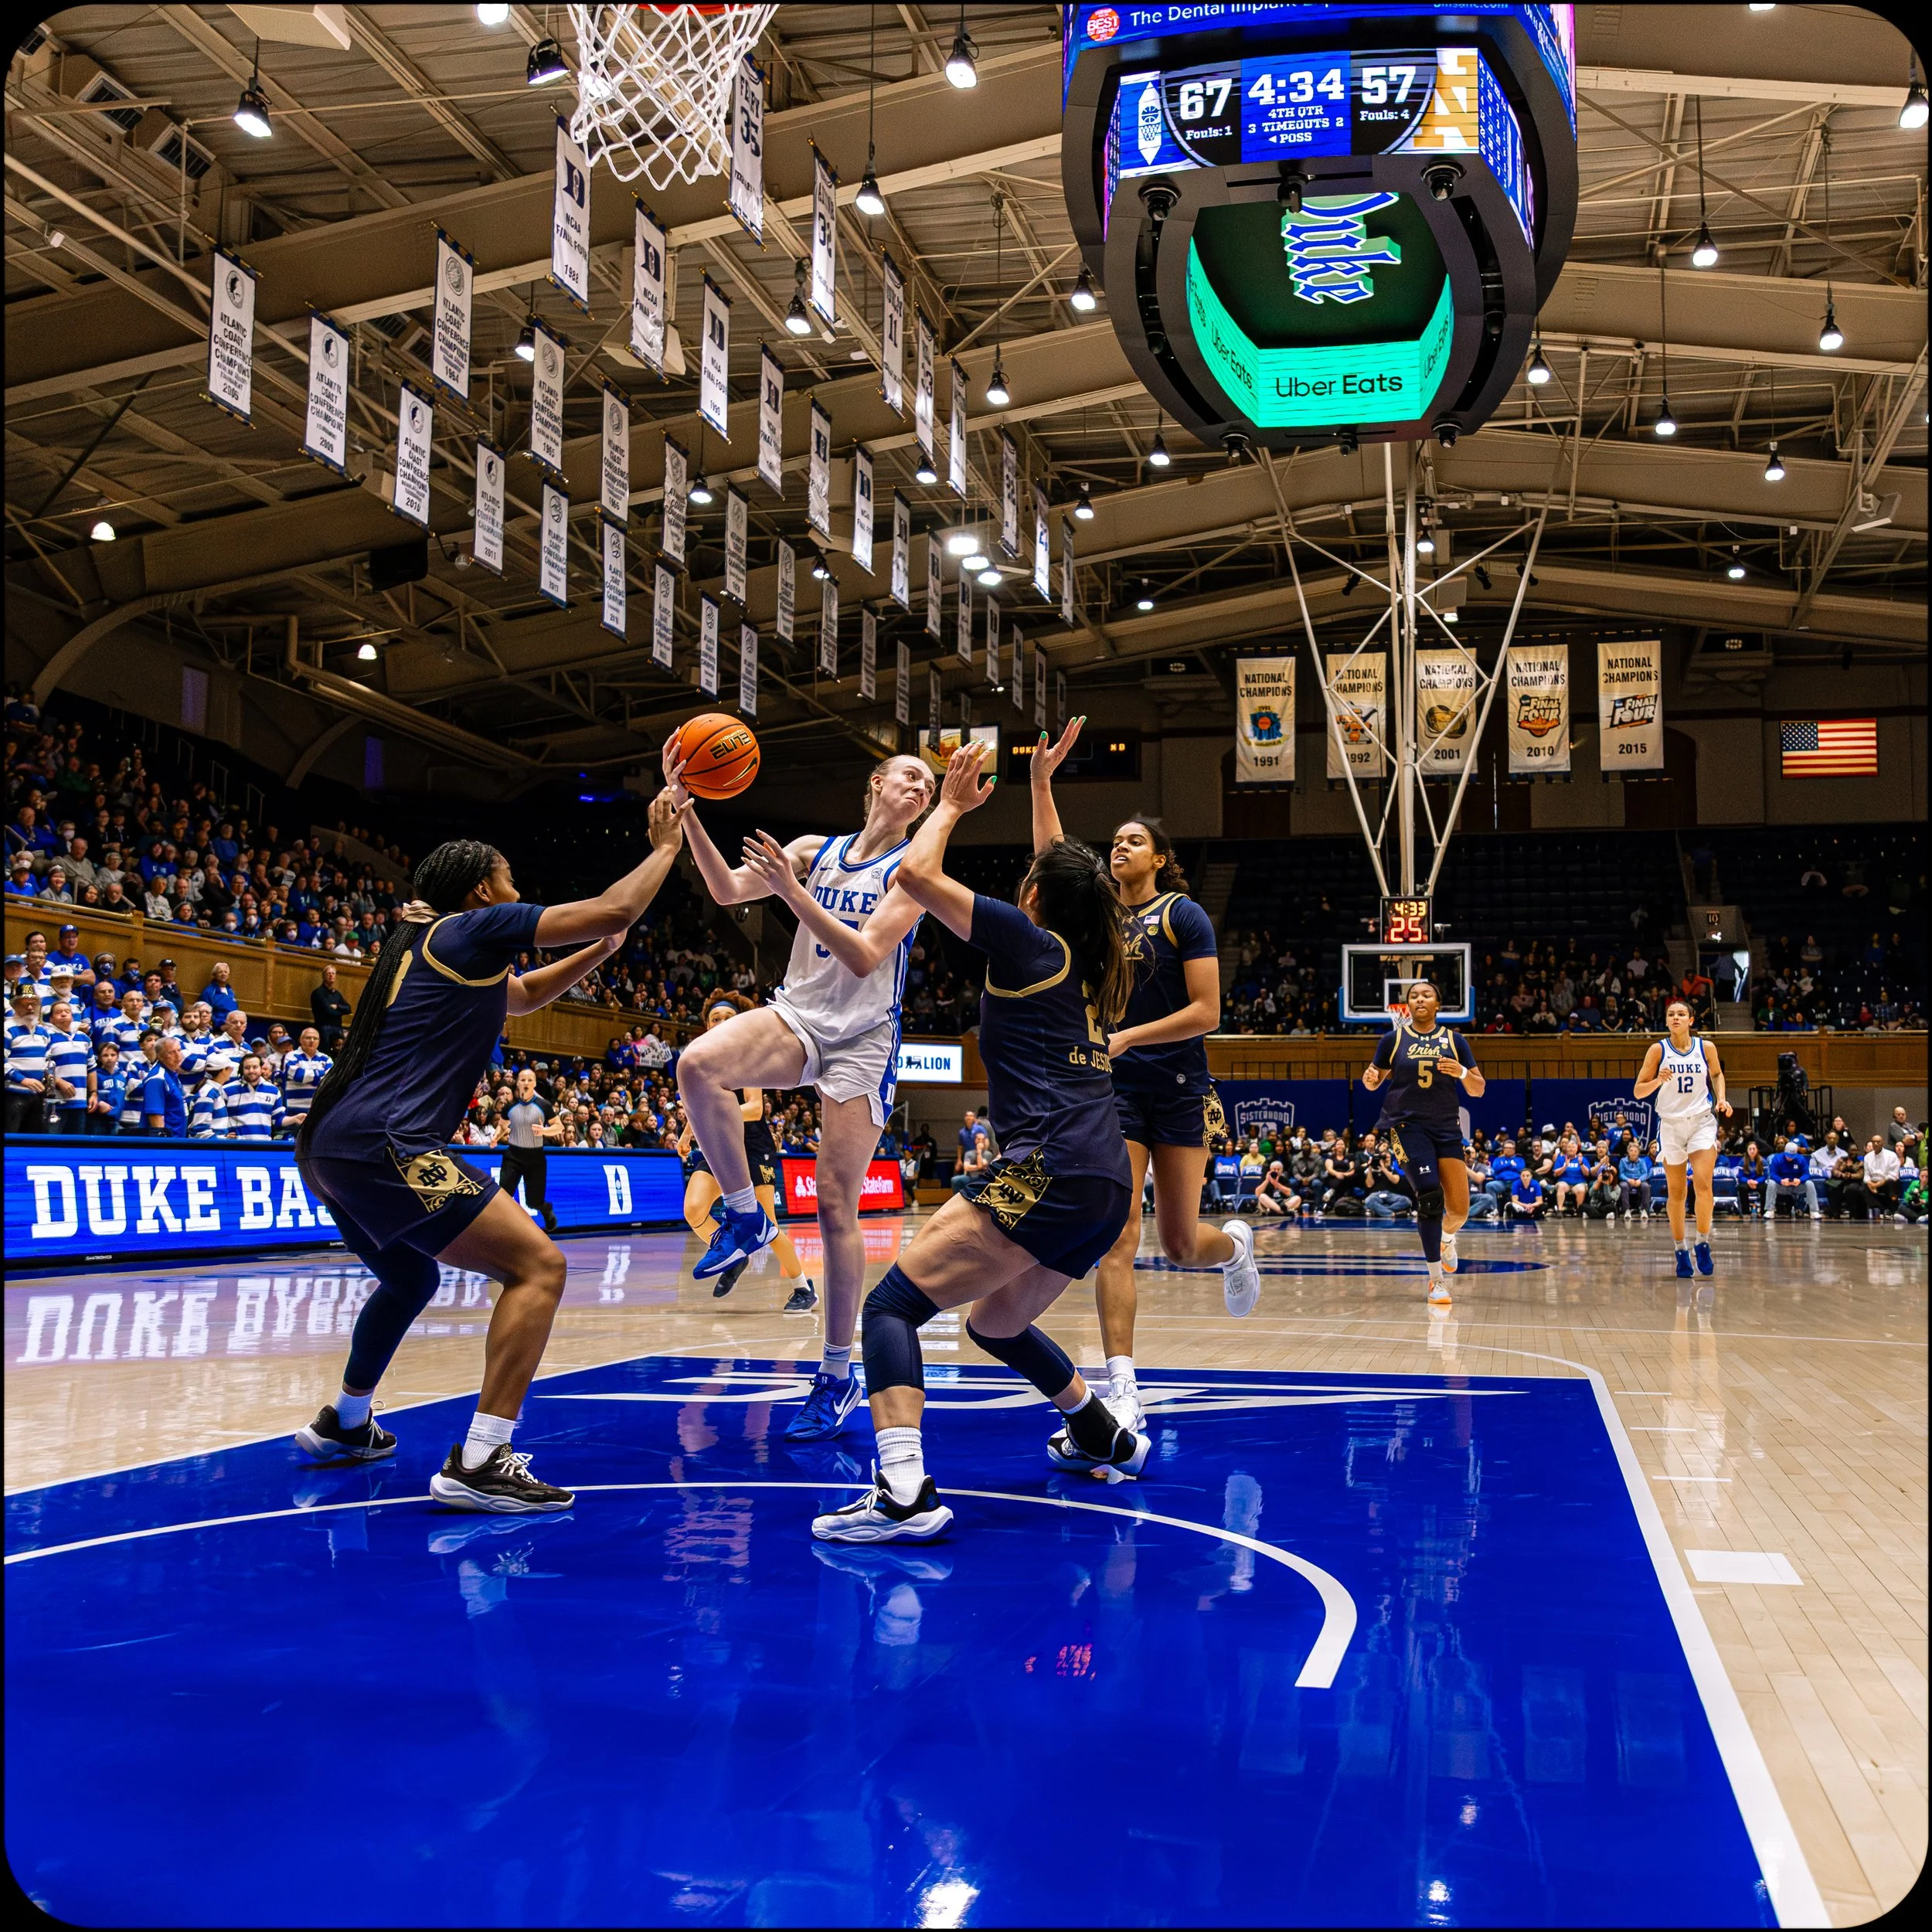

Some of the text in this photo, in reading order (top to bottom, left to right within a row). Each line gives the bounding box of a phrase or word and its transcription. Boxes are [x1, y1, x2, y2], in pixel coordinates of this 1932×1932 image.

[1130, 4, 1225, 26] The Dental
[1087, 17, 1118, 32] BEST
[1248, 70, 1345, 105] 4:34
[1362, 66, 1416, 104] 57
[1179, 78, 1232, 120] 67
[1268, 106, 1324, 118] 4TH QTR
[1359, 109, 1410, 121] Fouls: 4
[740, 106, 760, 158] 35
[1185, 126, 1232, 141] Fouls: 1
[1248, 117, 1344, 134] 3 TIMEOUTS 2
[1280, 132, 1312, 144] POSS
[566, 213, 581, 235] NCAA
[556, 224, 587, 261] FINAL FOUR
[643, 287, 658, 307] NCAA
[220, 312, 247, 338] ATLANTIC
[889, 313, 897, 348] 11
[224, 328, 243, 348] COAST
[213, 334, 252, 366] CONFERENCE
[215, 349, 250, 378] CHAMPIONS
[316, 372, 342, 394] ATLANTIC
[704, 366, 715, 386] FINAL
[1276, 372, 1403, 397] Uber Eats
[321, 386, 338, 403] COAST
[310, 393, 345, 422] CONFERENCE
[311, 406, 343, 433] CHAMPIONS
[404, 437, 426, 458] ATLANTIC
[409, 451, 422, 466] COAST
[398, 457, 429, 482] CONFERENCE
[400, 468, 427, 493] CHAMPIONS
[406, 497, 420, 512] 2010
[1425, 665, 1468, 676] NATIONAL
[1515, 660, 1560, 673] NATIONAL
[1607, 657, 1652, 669] NATIONAL
[1245, 672, 1287, 684] NATIONAL
[1420, 677, 1473, 689] CHAMPIONS
[1512, 674, 1565, 687] CHAMPIONS
[1602, 670, 1658, 683] CHAMPIONS
[1240, 685, 1292, 698] CHAMPIONS
[1333, 681, 1383, 694] HAMPIONS
[1530, 696, 1559, 709] FINAL
[1625, 696, 1656, 709] FINAL
[1519, 705, 1561, 723] FOUR
[1614, 706, 1656, 726] FOUR
[709, 732, 752, 760] ELITE
[1012, 745, 1038, 755] DUKE
[1434, 749, 1460, 760] 2001
[1526, 746, 1554, 757] 2010
[1618, 743, 1647, 754] 2015
[1253, 756, 1279, 767] 1991
[815, 886, 878, 915] DUKE
[1395, 901, 1427, 917] 4:33
[1390, 917, 1422, 942] 25
[1069, 1046, 1087, 1065] de
[1407, 1043, 1442, 1059] Irish
[924, 1057, 951, 1070] LION
[1669, 1063, 1701, 1073] DUKE
[1417, 1060, 1433, 1088] 5
[1677, 1077, 1693, 1094] 12
[1240, 1111, 1290, 1124] SISTERHOOD
[26, 1165, 221, 1239] DUKE
